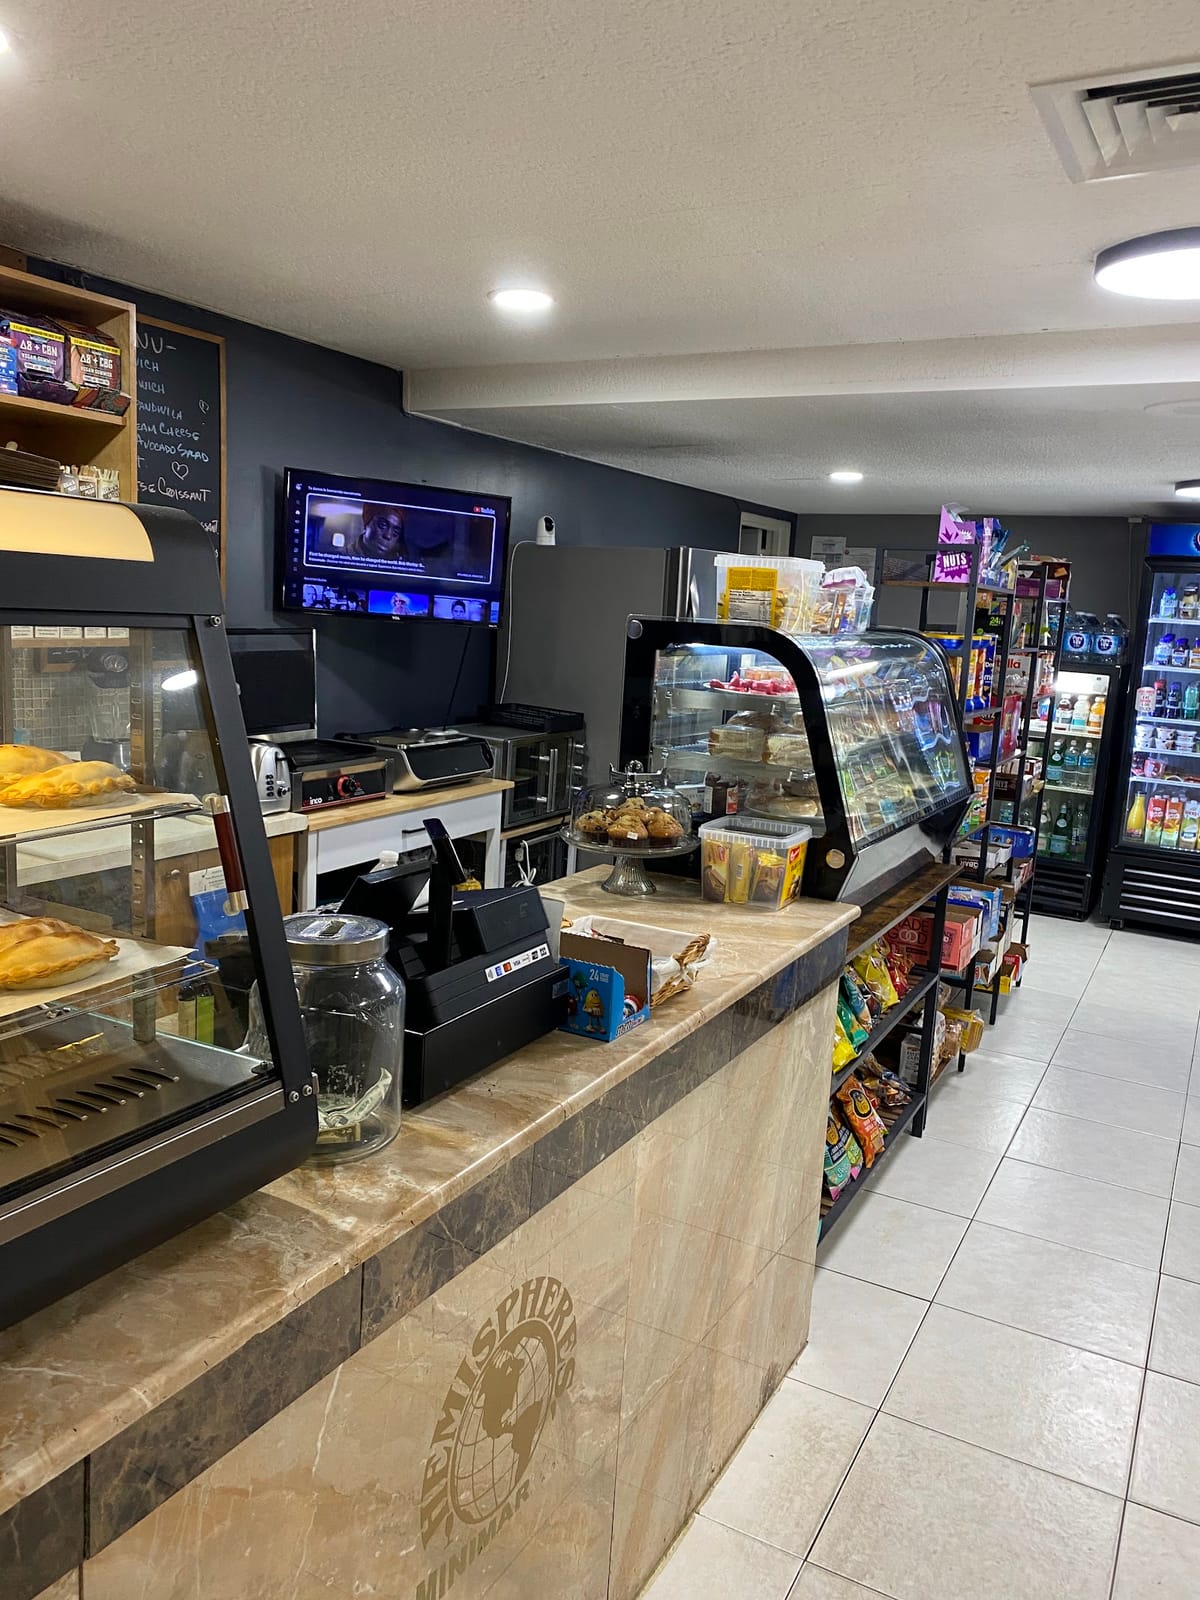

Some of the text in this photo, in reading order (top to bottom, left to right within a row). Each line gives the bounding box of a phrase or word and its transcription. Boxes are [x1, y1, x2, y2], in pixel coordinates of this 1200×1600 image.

[41, 343, 58, 358] CBN
[942, 552, 967, 569] NUTS
[888, 928, 928, 945] GOOD
[420, 1275, 577, 1550] HEMISPHERES
